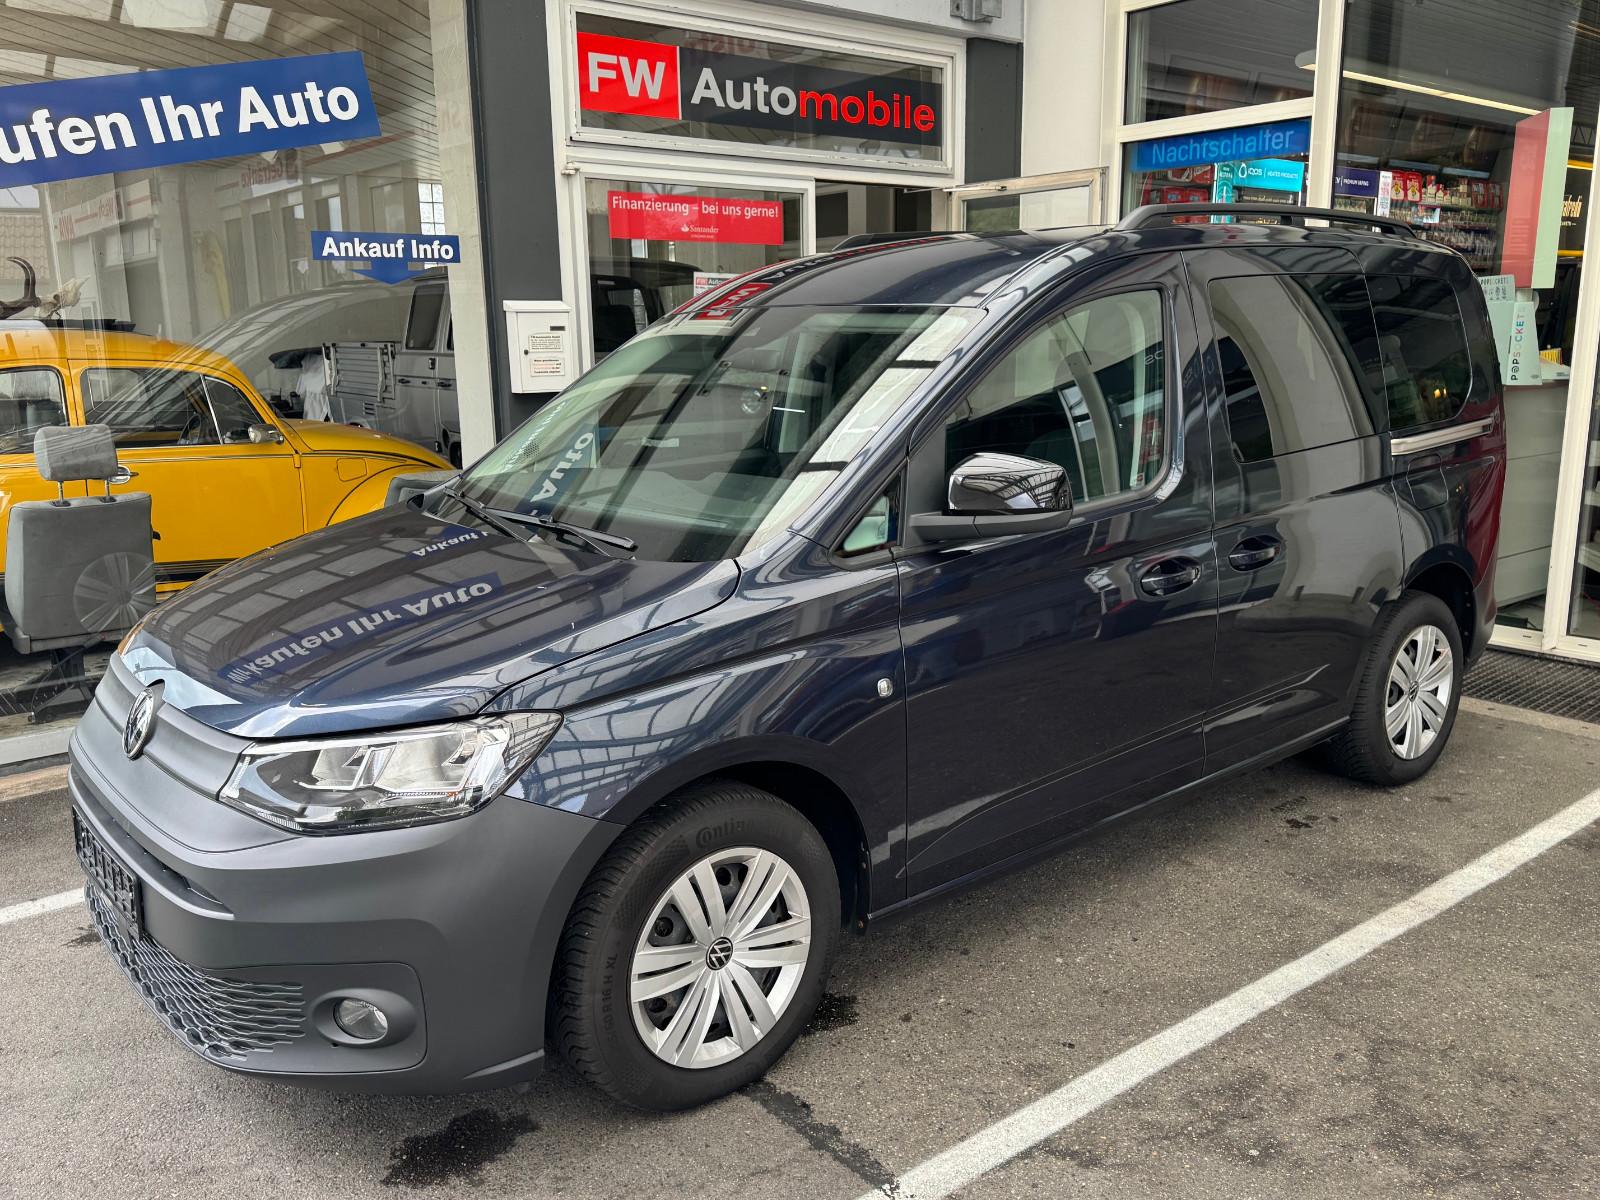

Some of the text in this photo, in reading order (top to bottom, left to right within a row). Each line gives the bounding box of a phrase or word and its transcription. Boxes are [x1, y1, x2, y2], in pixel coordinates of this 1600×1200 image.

[587, 51, 936, 132] FW Automobile
[140, 95, 223, 144] Ihr
[238, 81, 359, 133] Auto
[1152, 126, 1295, 165] Nachtschalter
[612, 196, 690, 215] Finanzierung
[701, 201, 719, 214] bei
[722, 205, 742, 216] uns
[744, 206, 779, 220] gerne!
[690, 223, 720, 233] Santander
[322, 237, 454, 260] Ankauf Info
